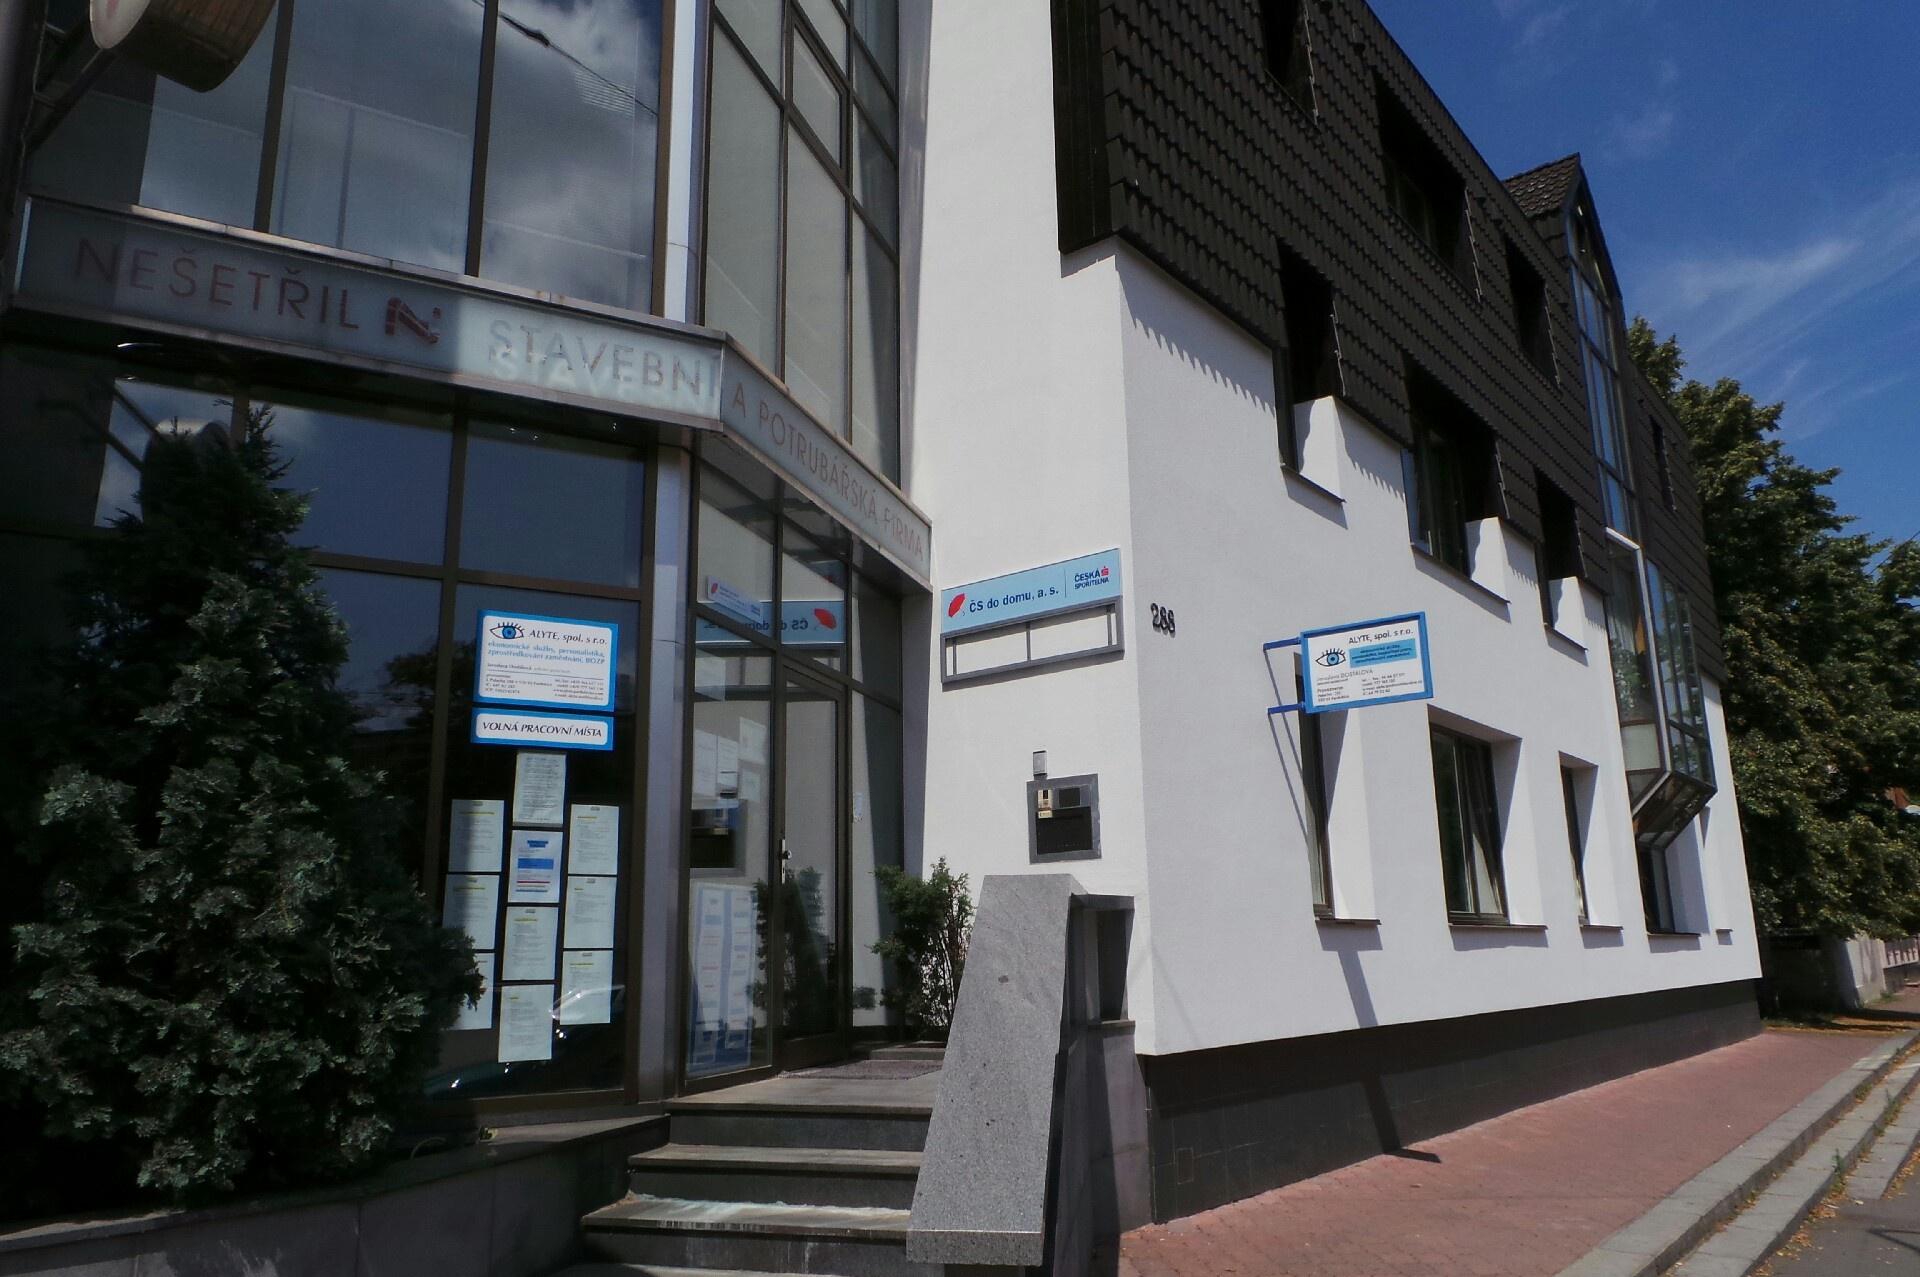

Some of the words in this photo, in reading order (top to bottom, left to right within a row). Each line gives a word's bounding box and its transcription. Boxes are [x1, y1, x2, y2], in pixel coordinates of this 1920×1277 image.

[73, 238, 360, 330] NEŠETŘIL
[732, 382, 747, 419] A
[758, 400, 879, 526] POTRUBÁŘSKÁ
[882, 507, 924, 562] FIRMA
[1074, 567, 1101, 583] ČESKÁ
[1074, 576, 1110, 590] SPOŘITELNA
[969, 599, 984, 613] ČS
[986, 597, 1000, 610] do
[1002, 591, 1035, 607] domu,
[1150, 602, 1176, 634] 288
[529, 630, 560, 640] ALYTE,
[563, 633, 584, 643] spol.
[1349, 634, 1373, 643] ALYTE,
[1374, 630, 1391, 641] spol.
[483, 720, 519, 732] VOLNÁ
[521, 724, 574, 735] PRACOVNÍ
[574, 725, 602, 738] MÍSTA
